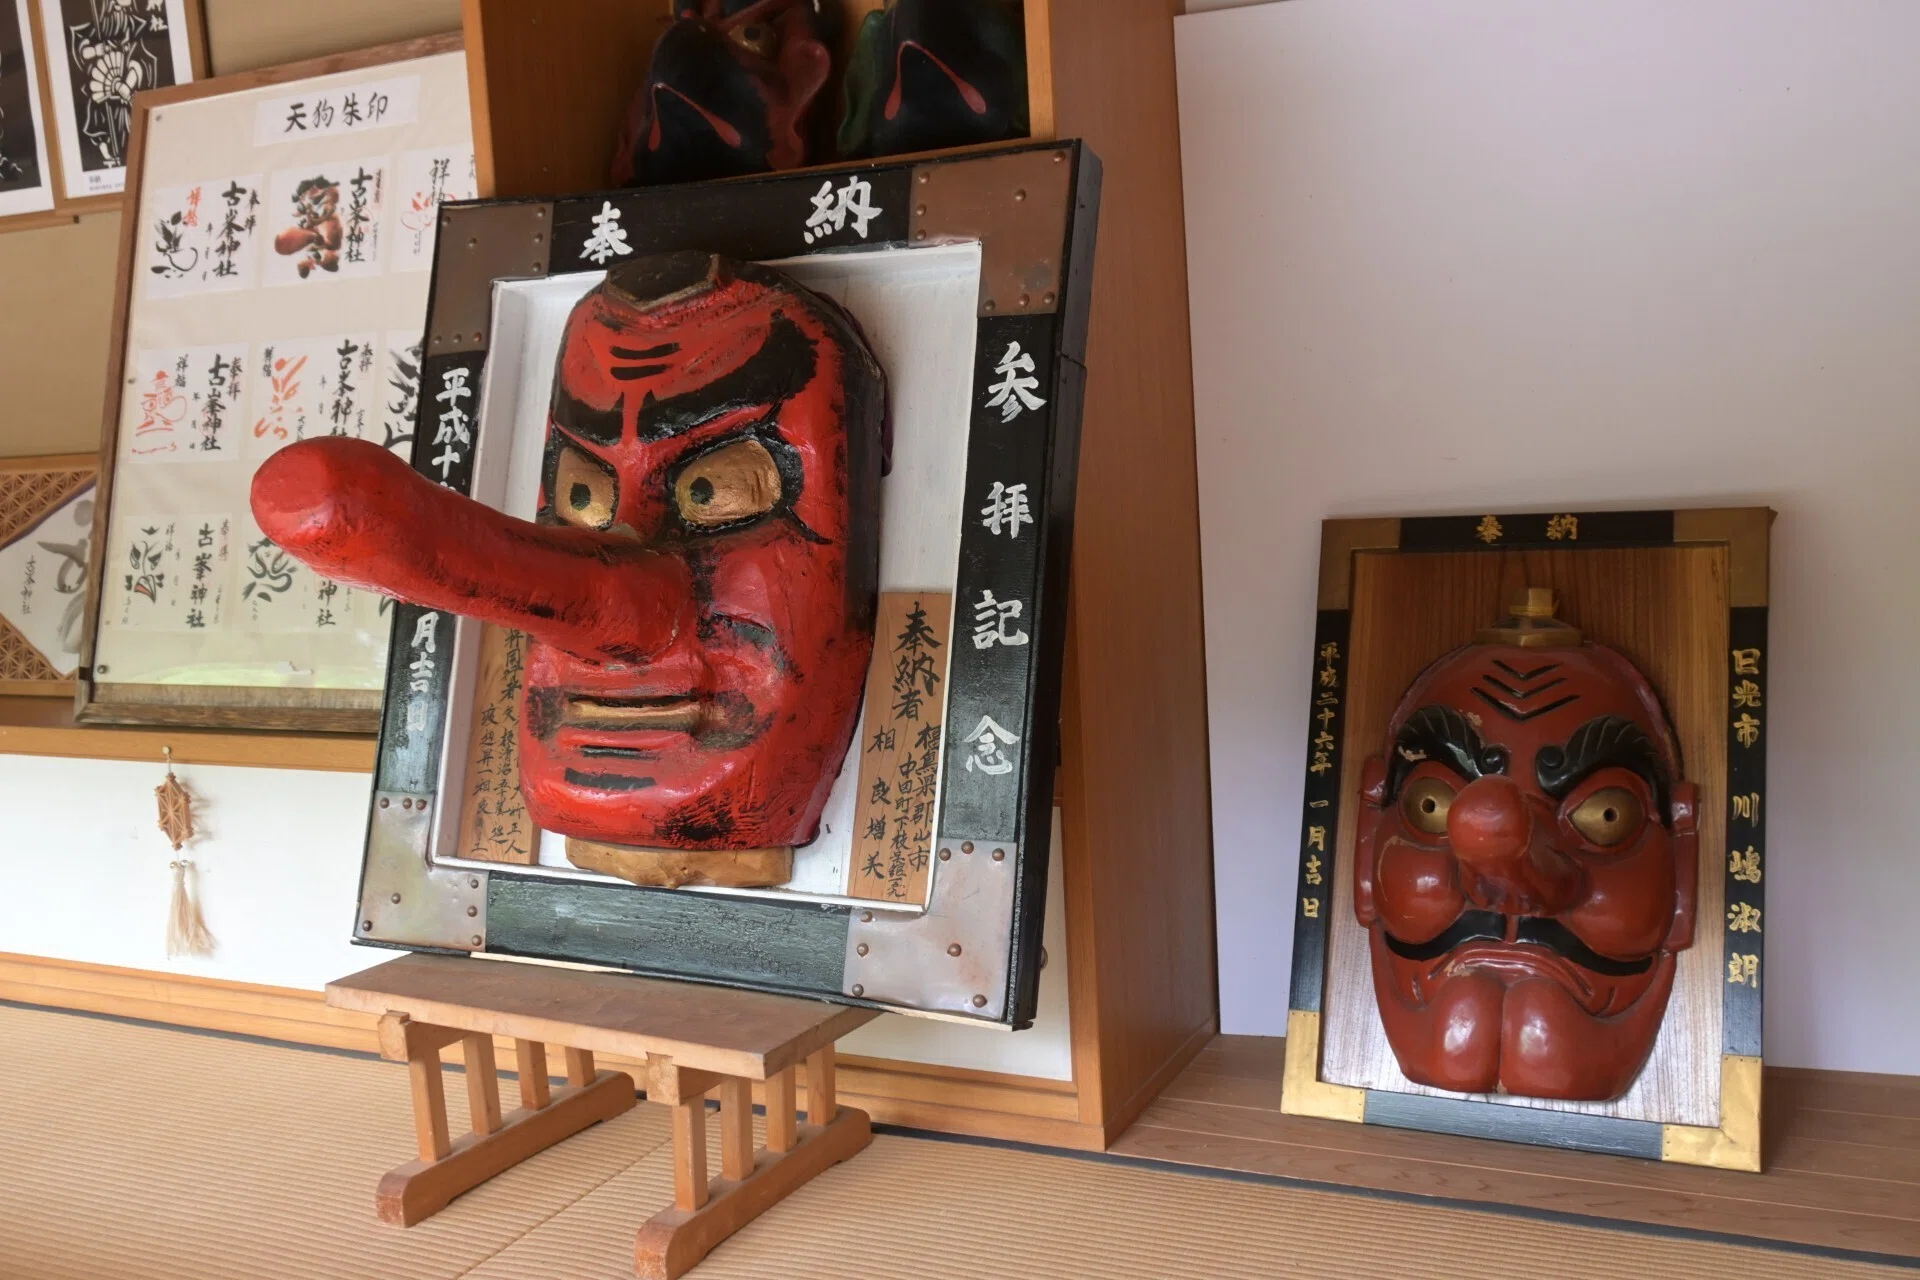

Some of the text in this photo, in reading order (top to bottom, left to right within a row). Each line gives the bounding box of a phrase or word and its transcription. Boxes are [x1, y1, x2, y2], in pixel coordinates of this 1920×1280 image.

[284, 91, 388, 133] 天狗朱印
[580, 176, 882, 264] 奉納
[432, 367, 471, 491] 平成十
[963, 340, 1048, 776] 参拝記念
[1476, 514, 1578, 544] 奉納
[406, 611, 440, 731] 月吉日
[892, 602, 943, 722] 奉納者
